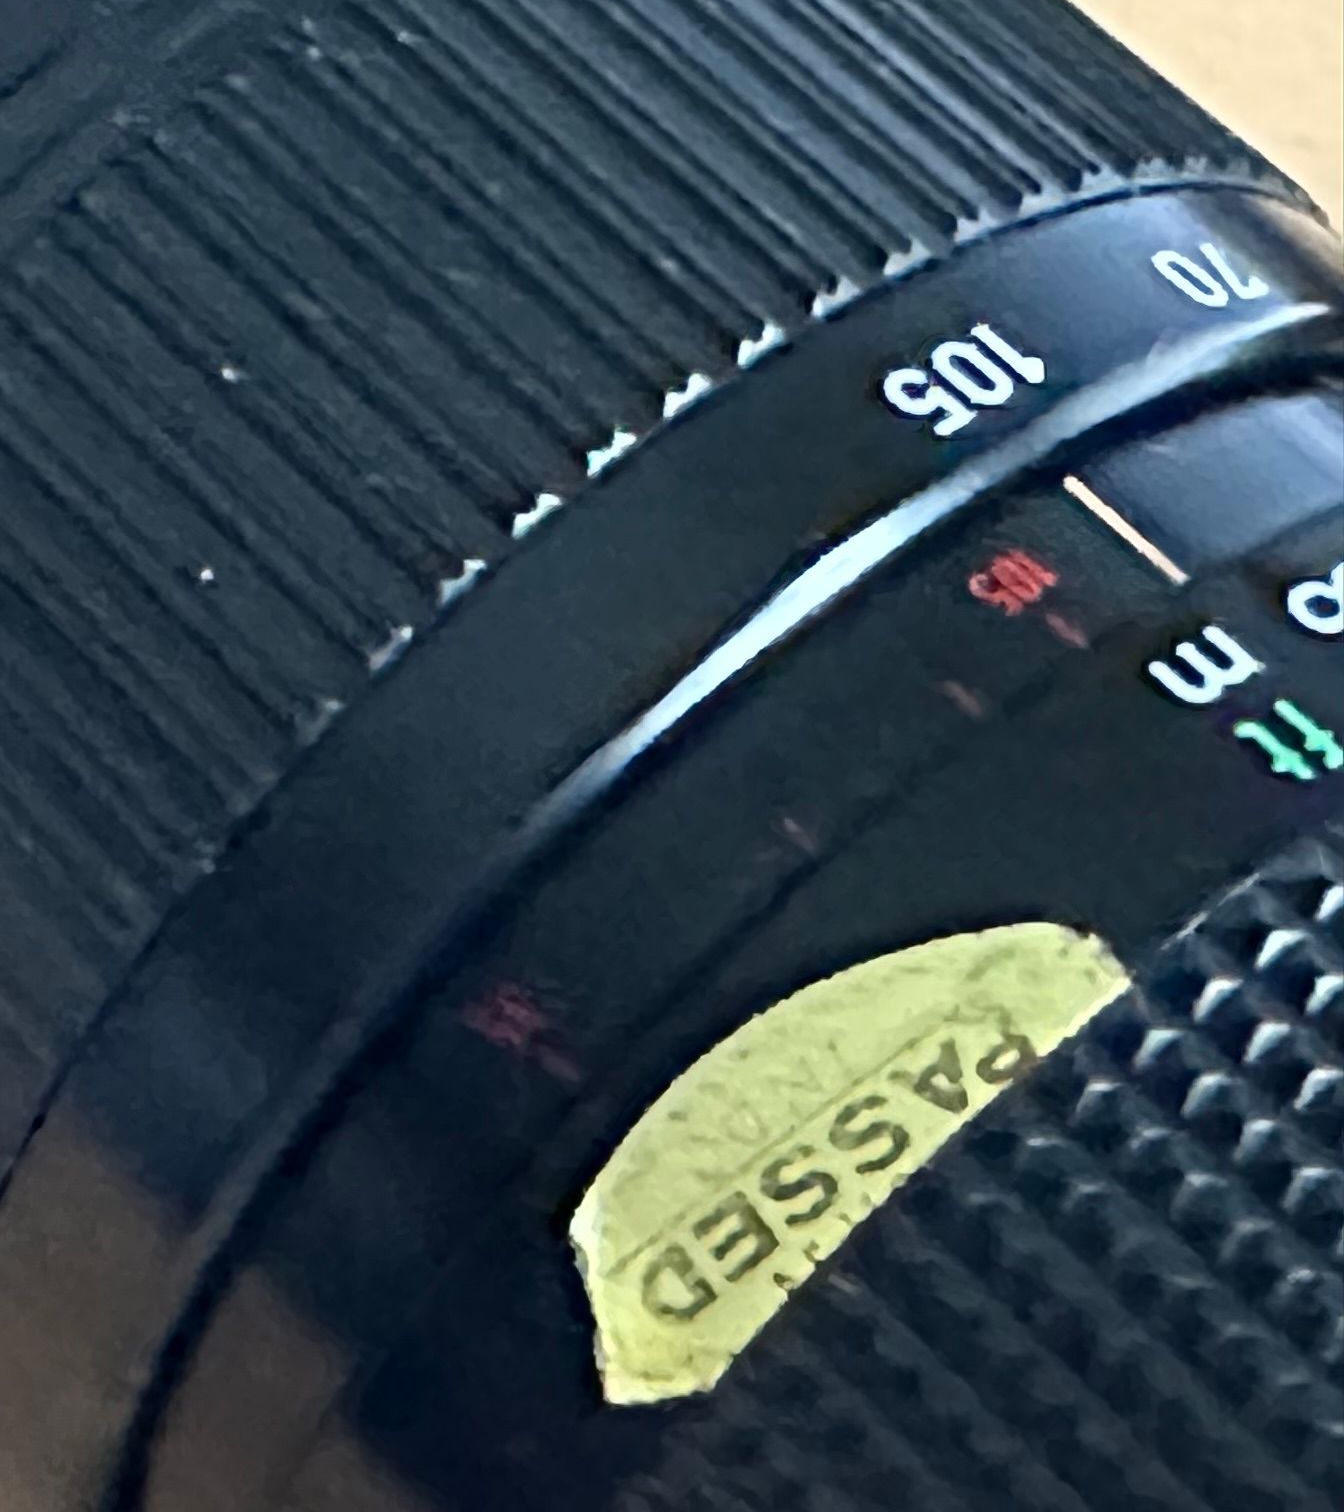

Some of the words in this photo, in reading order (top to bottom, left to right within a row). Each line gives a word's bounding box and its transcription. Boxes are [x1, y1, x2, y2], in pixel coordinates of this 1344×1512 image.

[1152, 243, 1269, 307] 70
[884, 324, 1045, 436] 105
[1149, 626, 1265, 704] m
[1235, 699, 1344, 780] ft
[639, 1020, 1040, 1321] PASSED
